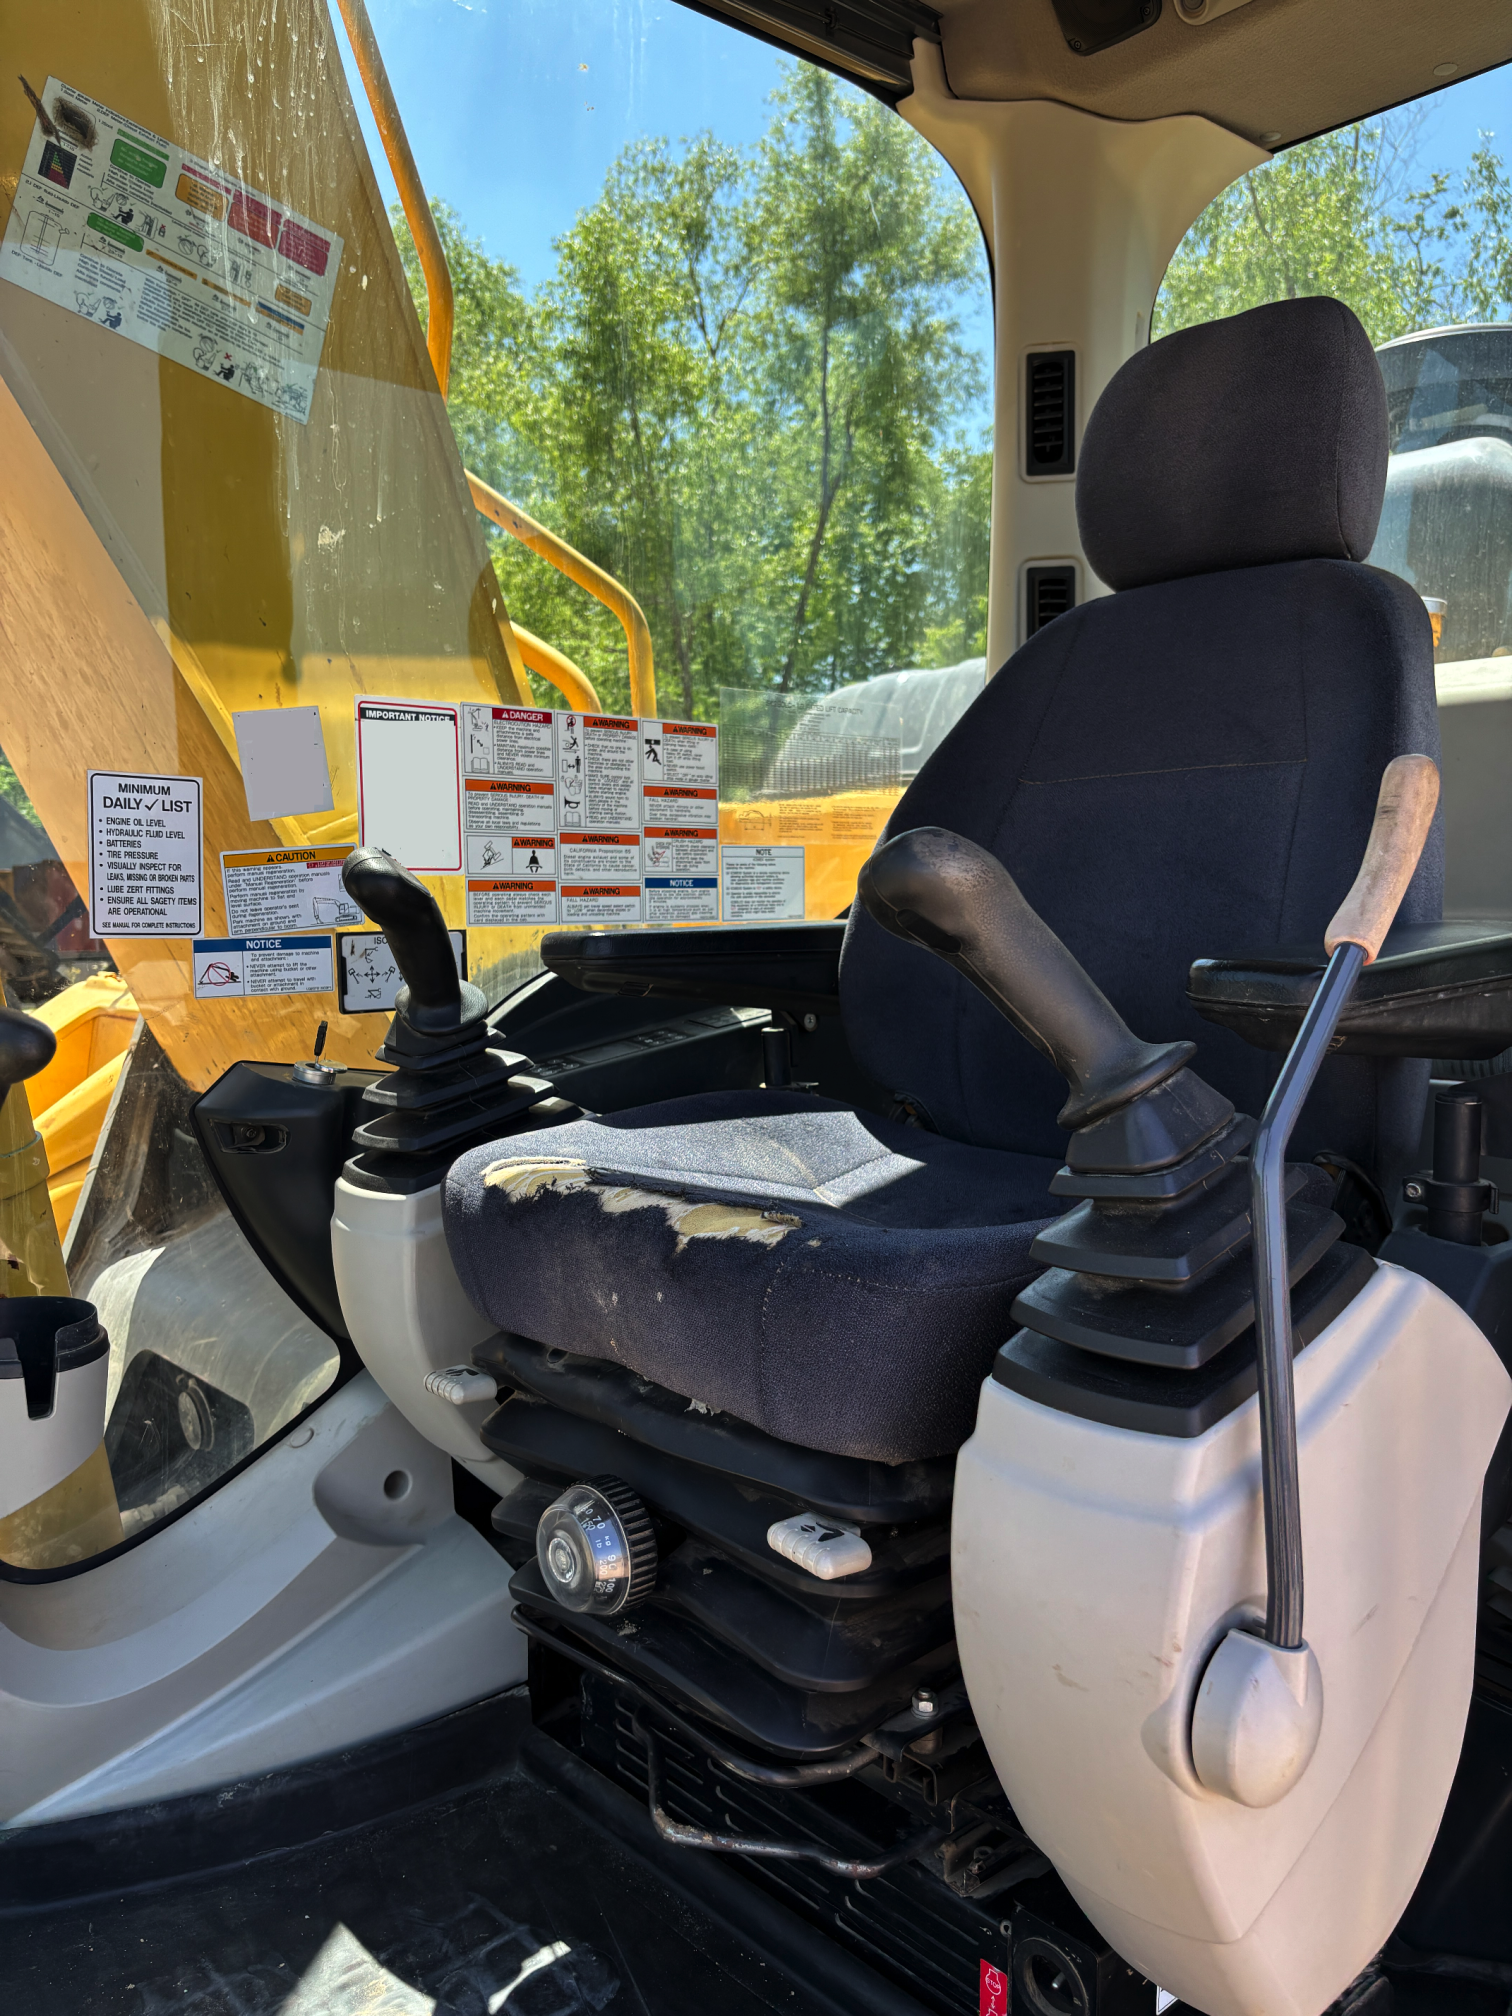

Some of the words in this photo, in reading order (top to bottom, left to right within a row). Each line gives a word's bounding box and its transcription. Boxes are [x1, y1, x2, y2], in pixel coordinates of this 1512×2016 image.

[365, 710, 416, 721] IMPORTANT
[510, 711, 543, 721] DANGER
[598, 720, 629, 729] WARNING
[678, 726, 707, 735] WARNING
[118, 783, 170, 796] MINIMUM
[497, 784, 531, 792] WARNING
[669, 789, 698, 797] WARNING
[103, 796, 143, 810] DAILY
[162, 799, 192, 812] LIST
[106, 817, 131, 825] ENGINE
[146, 819, 166, 827] LEVEL
[106, 828, 143, 837] HYDRAULIC
[146, 830, 163, 838] FLUID
[166, 831, 185, 839] LEVEL
[106, 840, 141, 848] BATTERIES
[519, 839, 553, 847] WARNING
[124, 851, 158, 859] PRESSURE
[275, 851, 316, 862] CAUTION
[107, 862, 137, 870] VISUALLY
[139, 863, 166, 871] INSPECT
[107, 873, 125, 882] LEAKS,
[149, 874, 156, 882] OR
[158, 874, 178, 882] BROKEN
[107, 885, 124, 893] LUBE
[146, 886, 174, 894] FITTINGS
[107, 896, 134, 904] ENSURE
[124, 908, 167, 916] OPERATIONAL
[246, 939, 282, 949] NOTICE
[593, 1515, 605, 1529] 70
[595, 1539, 602, 1548] lb
[600, 1560, 608, 1575] 200
[605, 1578, 616, 1592] 100
[986, 1978, 1000, 1989] STOP
